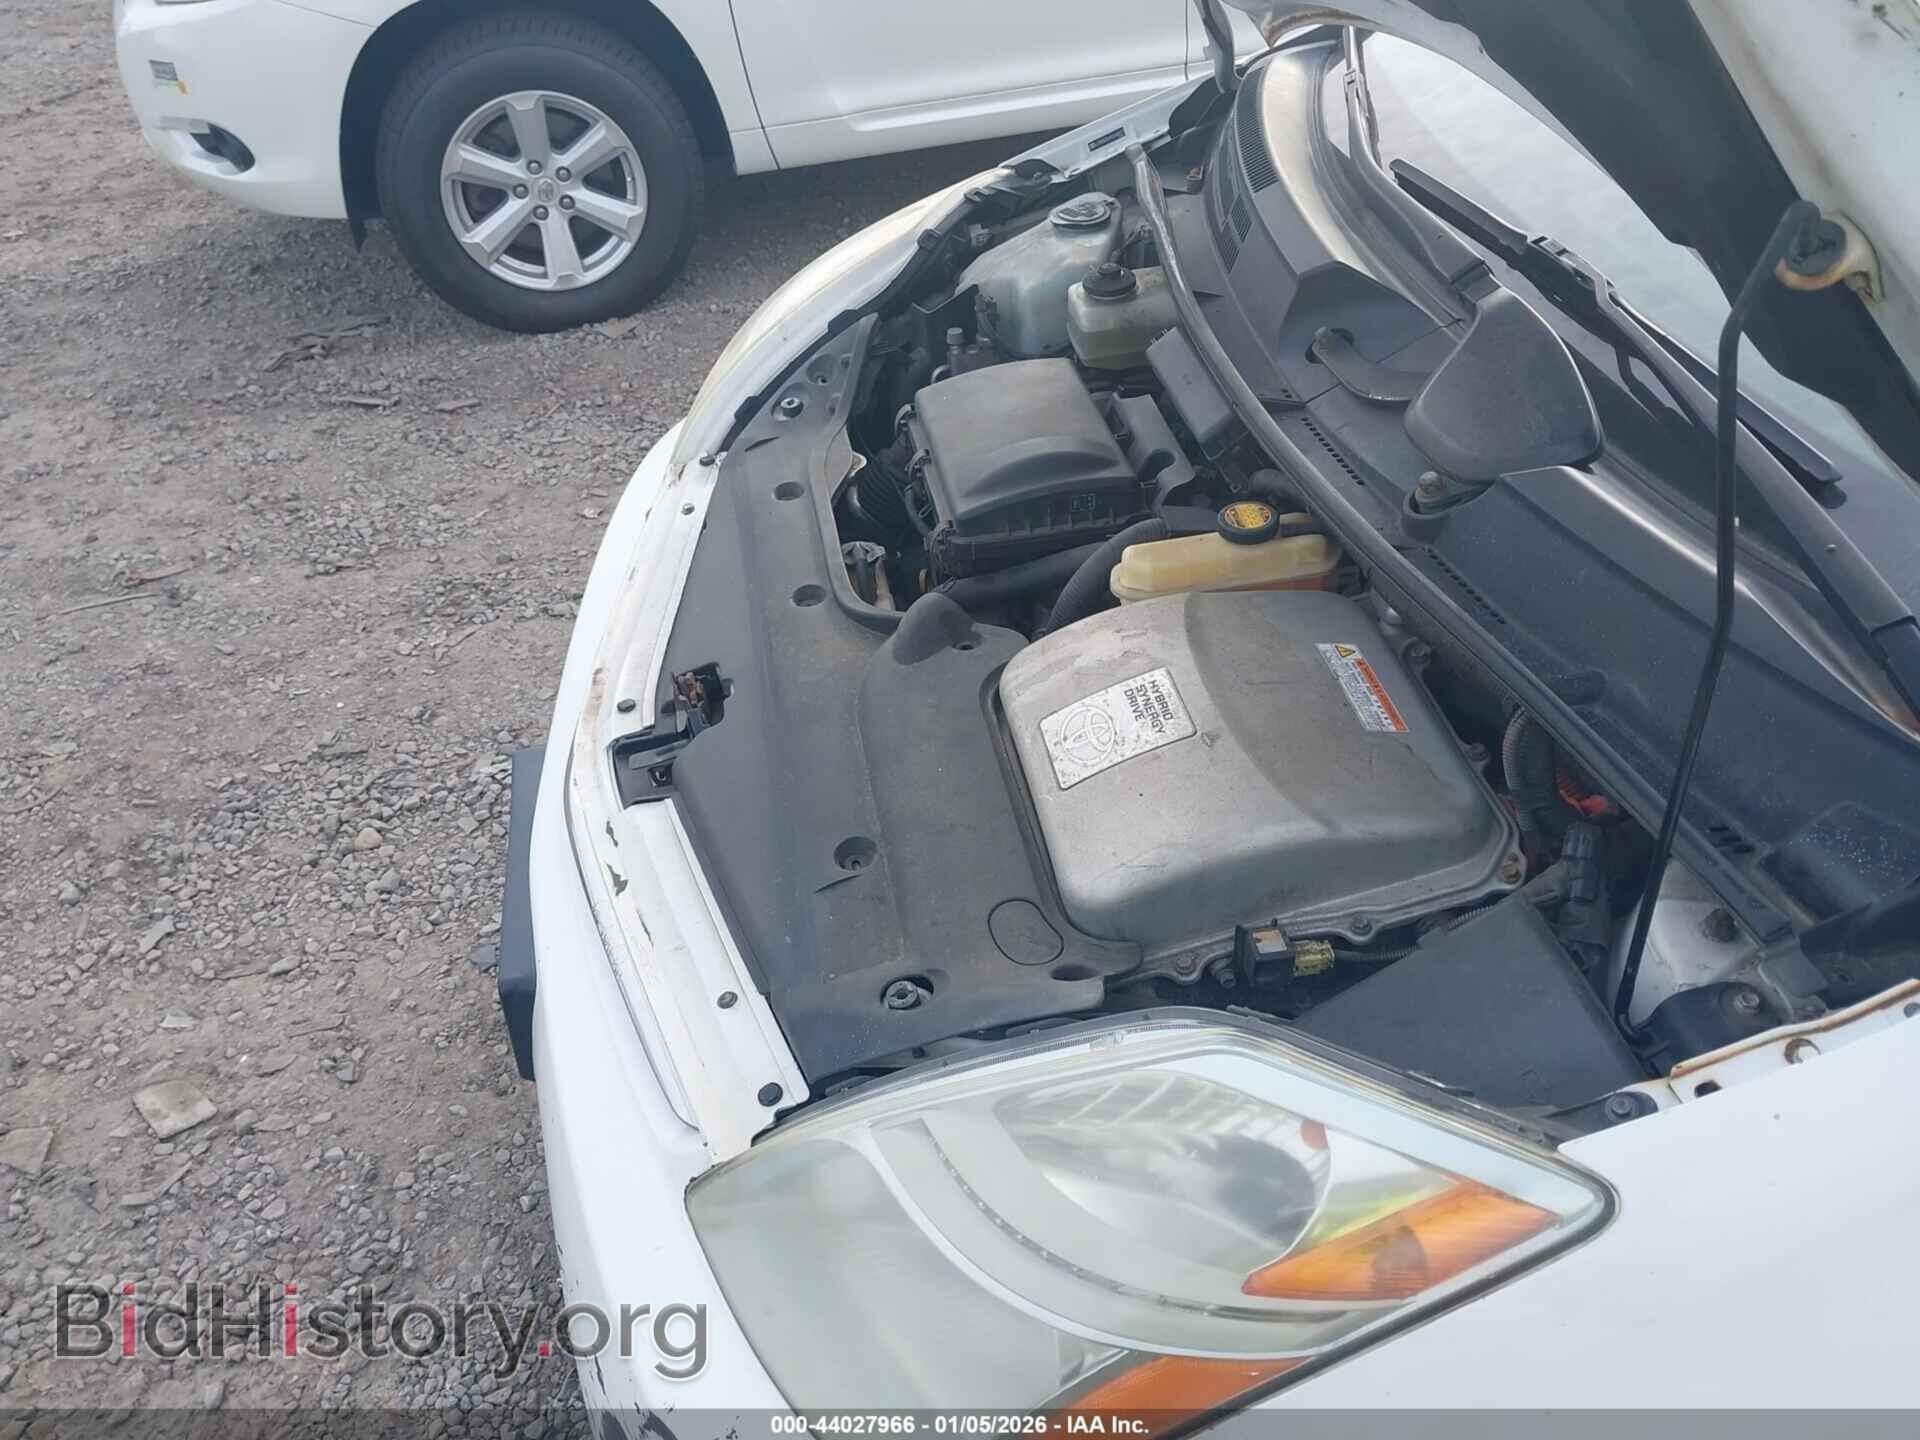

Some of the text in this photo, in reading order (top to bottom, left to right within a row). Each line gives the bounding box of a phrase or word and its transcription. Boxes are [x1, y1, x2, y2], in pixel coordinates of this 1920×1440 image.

[1123, 688, 1146, 722] DRIVE
[1135, 684, 1166, 734] SYNERGY
[1147, 679, 1174, 721] HYBRID
